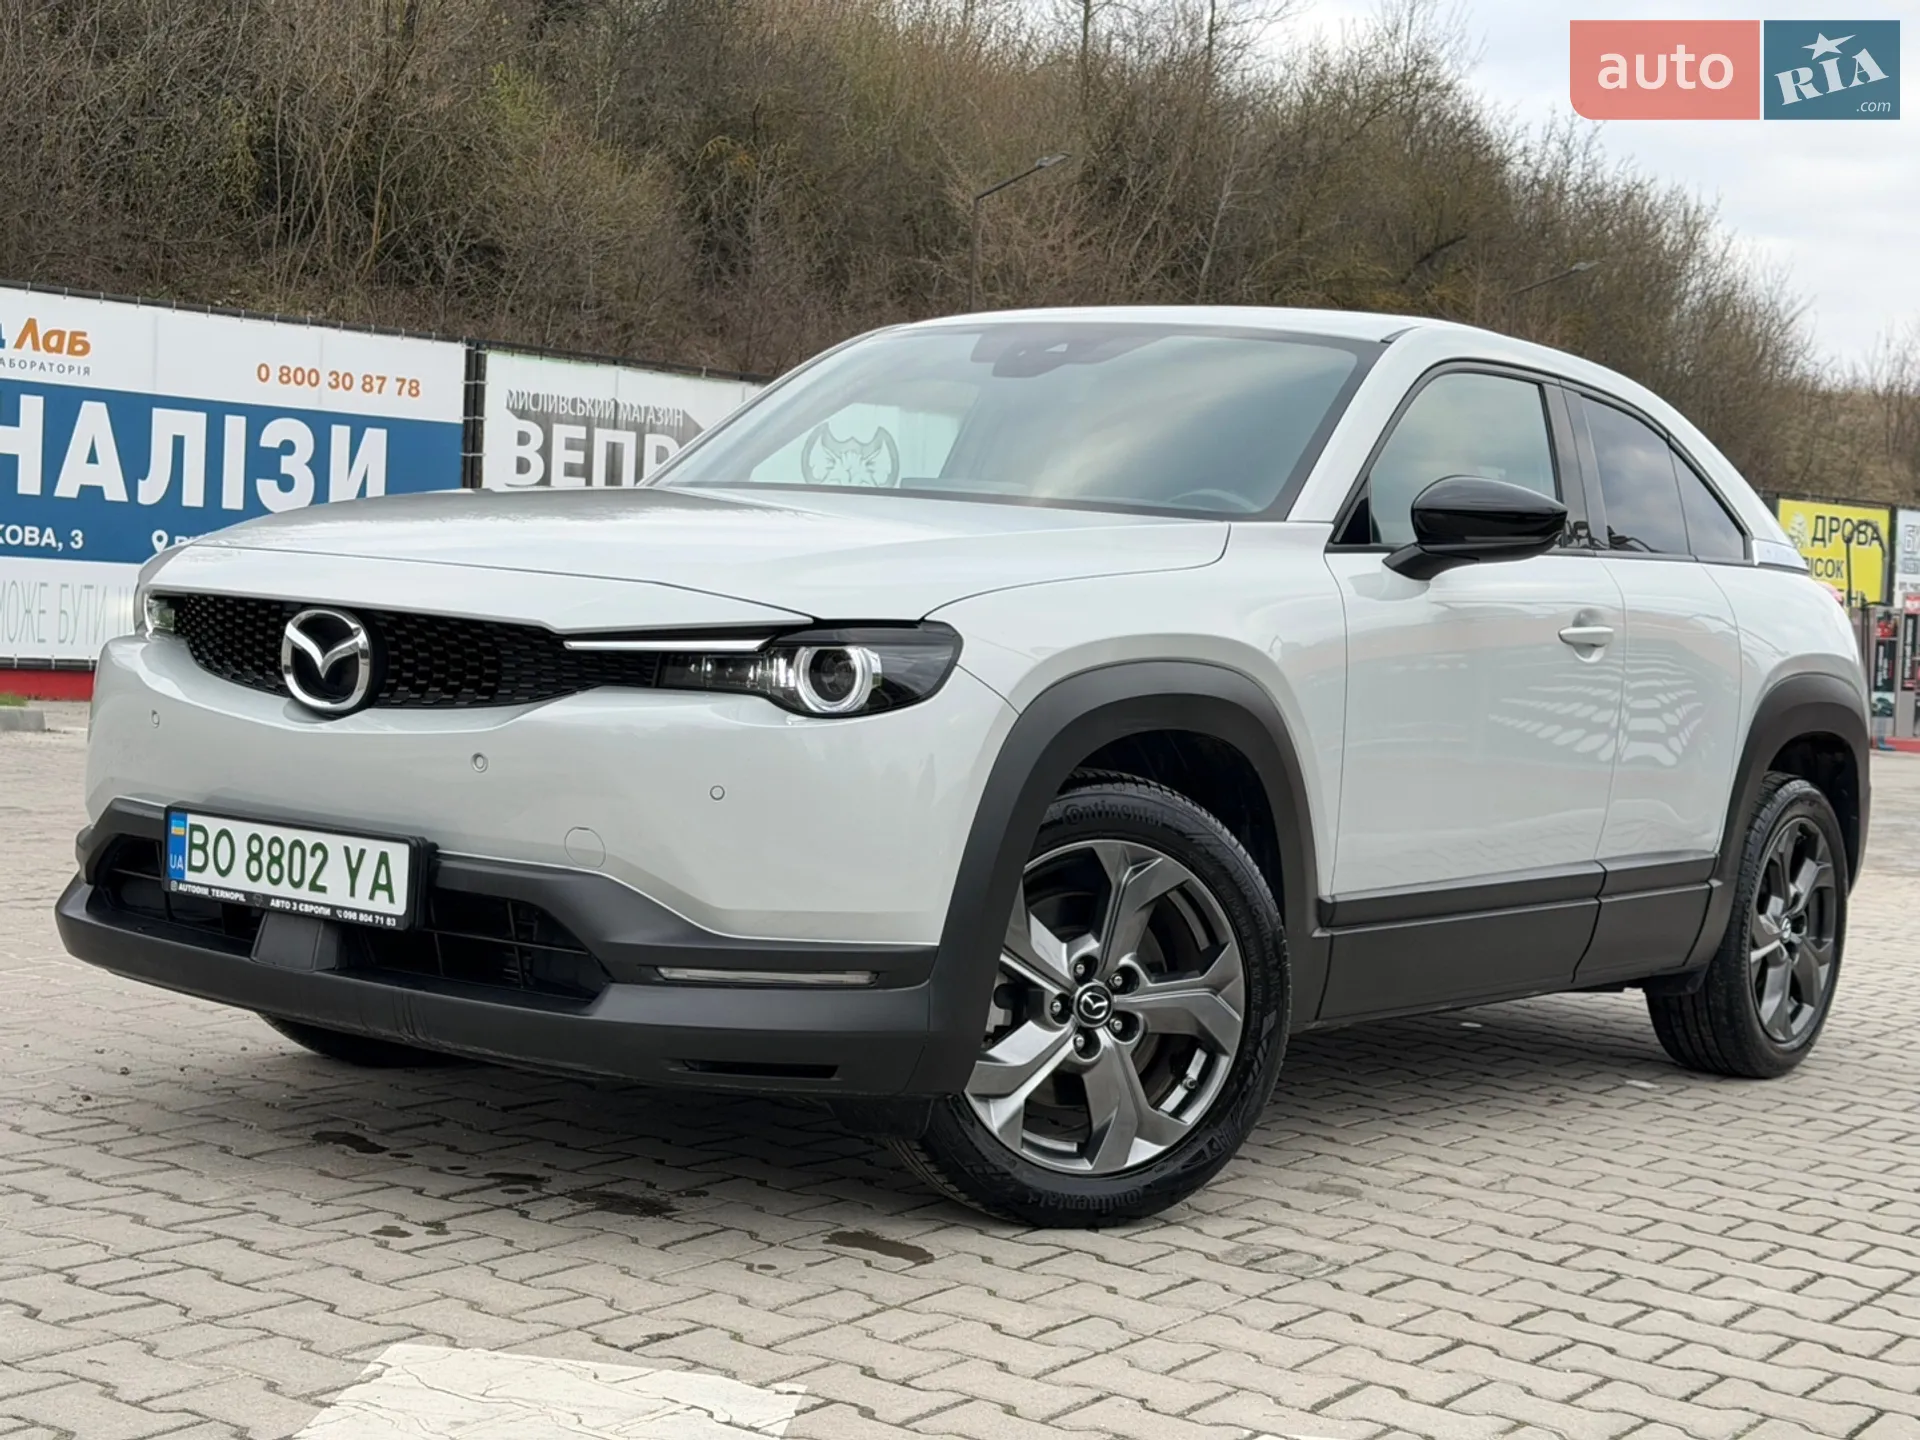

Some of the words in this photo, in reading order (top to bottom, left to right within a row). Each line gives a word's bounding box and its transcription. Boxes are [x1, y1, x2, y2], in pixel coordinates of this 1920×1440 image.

[13, 317, 91, 357] Лаб
[257, 363, 271, 383] 0
[278, 366, 320, 388] 800
[328, 370, 354, 392] 30
[361, 374, 388, 395] 87
[395, 378, 421, 398] 78
[506, 389, 614, 423] МИСЛИВСЬКИЙ
[618, 402, 684, 427] МАГАЗИН
[70, 529, 84, 550] 3
[1812, 515, 1884, 549] ДРОВА
[58, 583, 107, 645] БУТИ
[170, 853, 184, 871] UA
[187, 823, 236, 878] BO
[245, 833, 329, 894] 8802
[343, 845, 395, 904] YA
